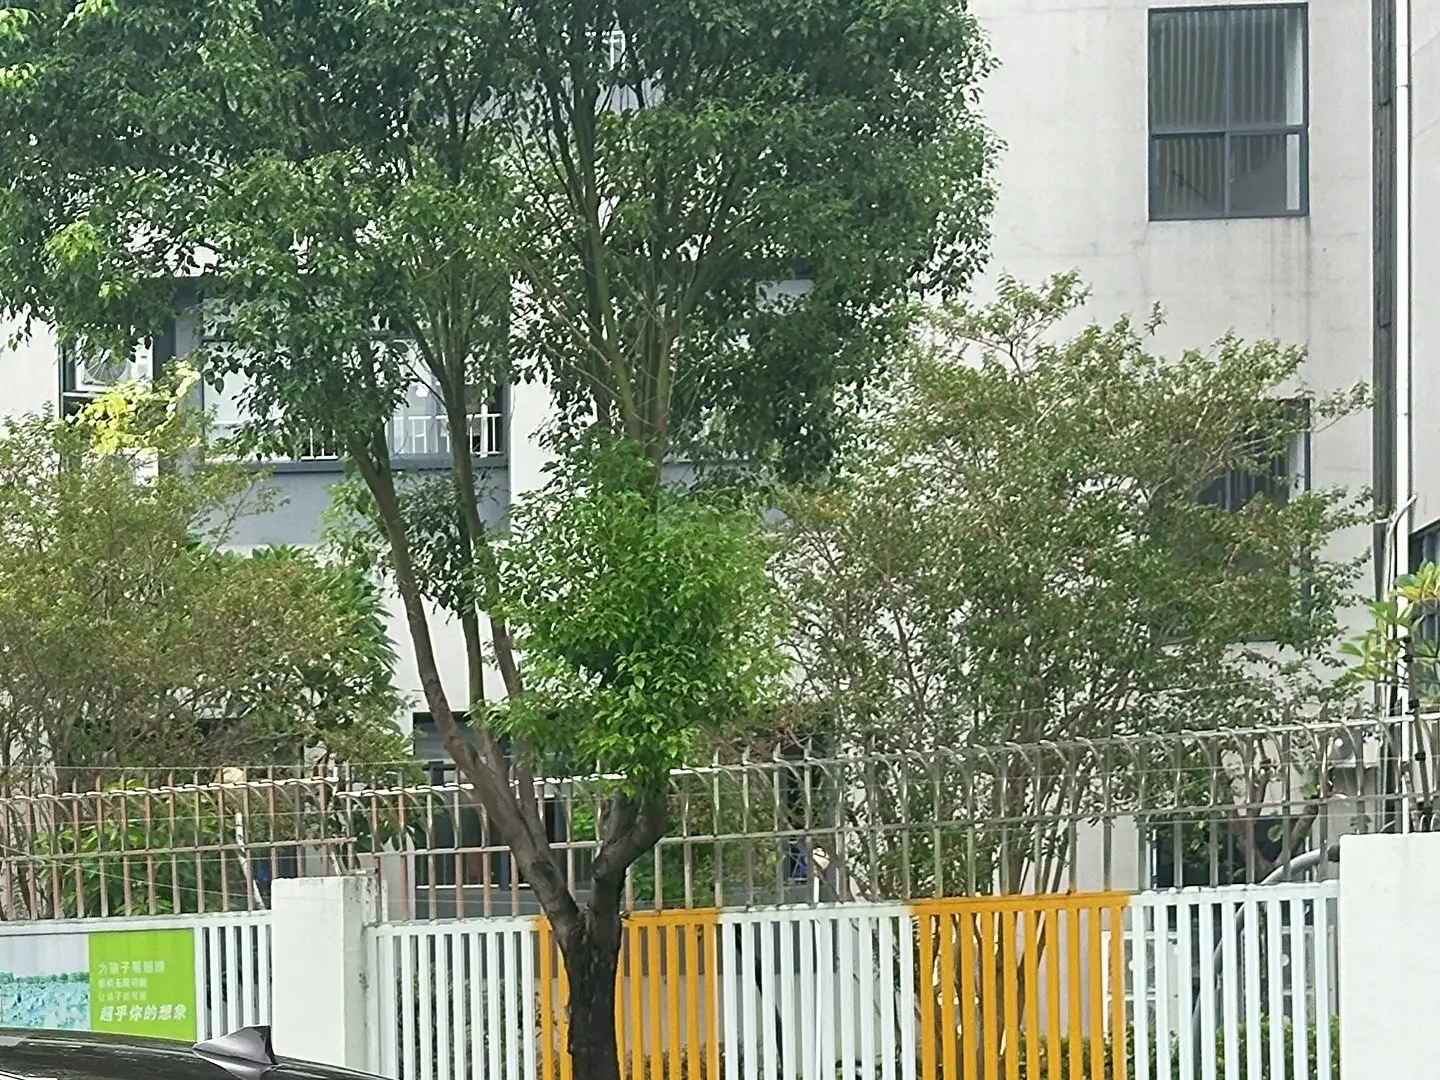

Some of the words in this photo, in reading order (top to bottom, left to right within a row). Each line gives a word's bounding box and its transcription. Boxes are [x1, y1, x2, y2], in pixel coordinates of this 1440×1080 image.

[99, 1003, 187, 1022] 超乎你的想象
